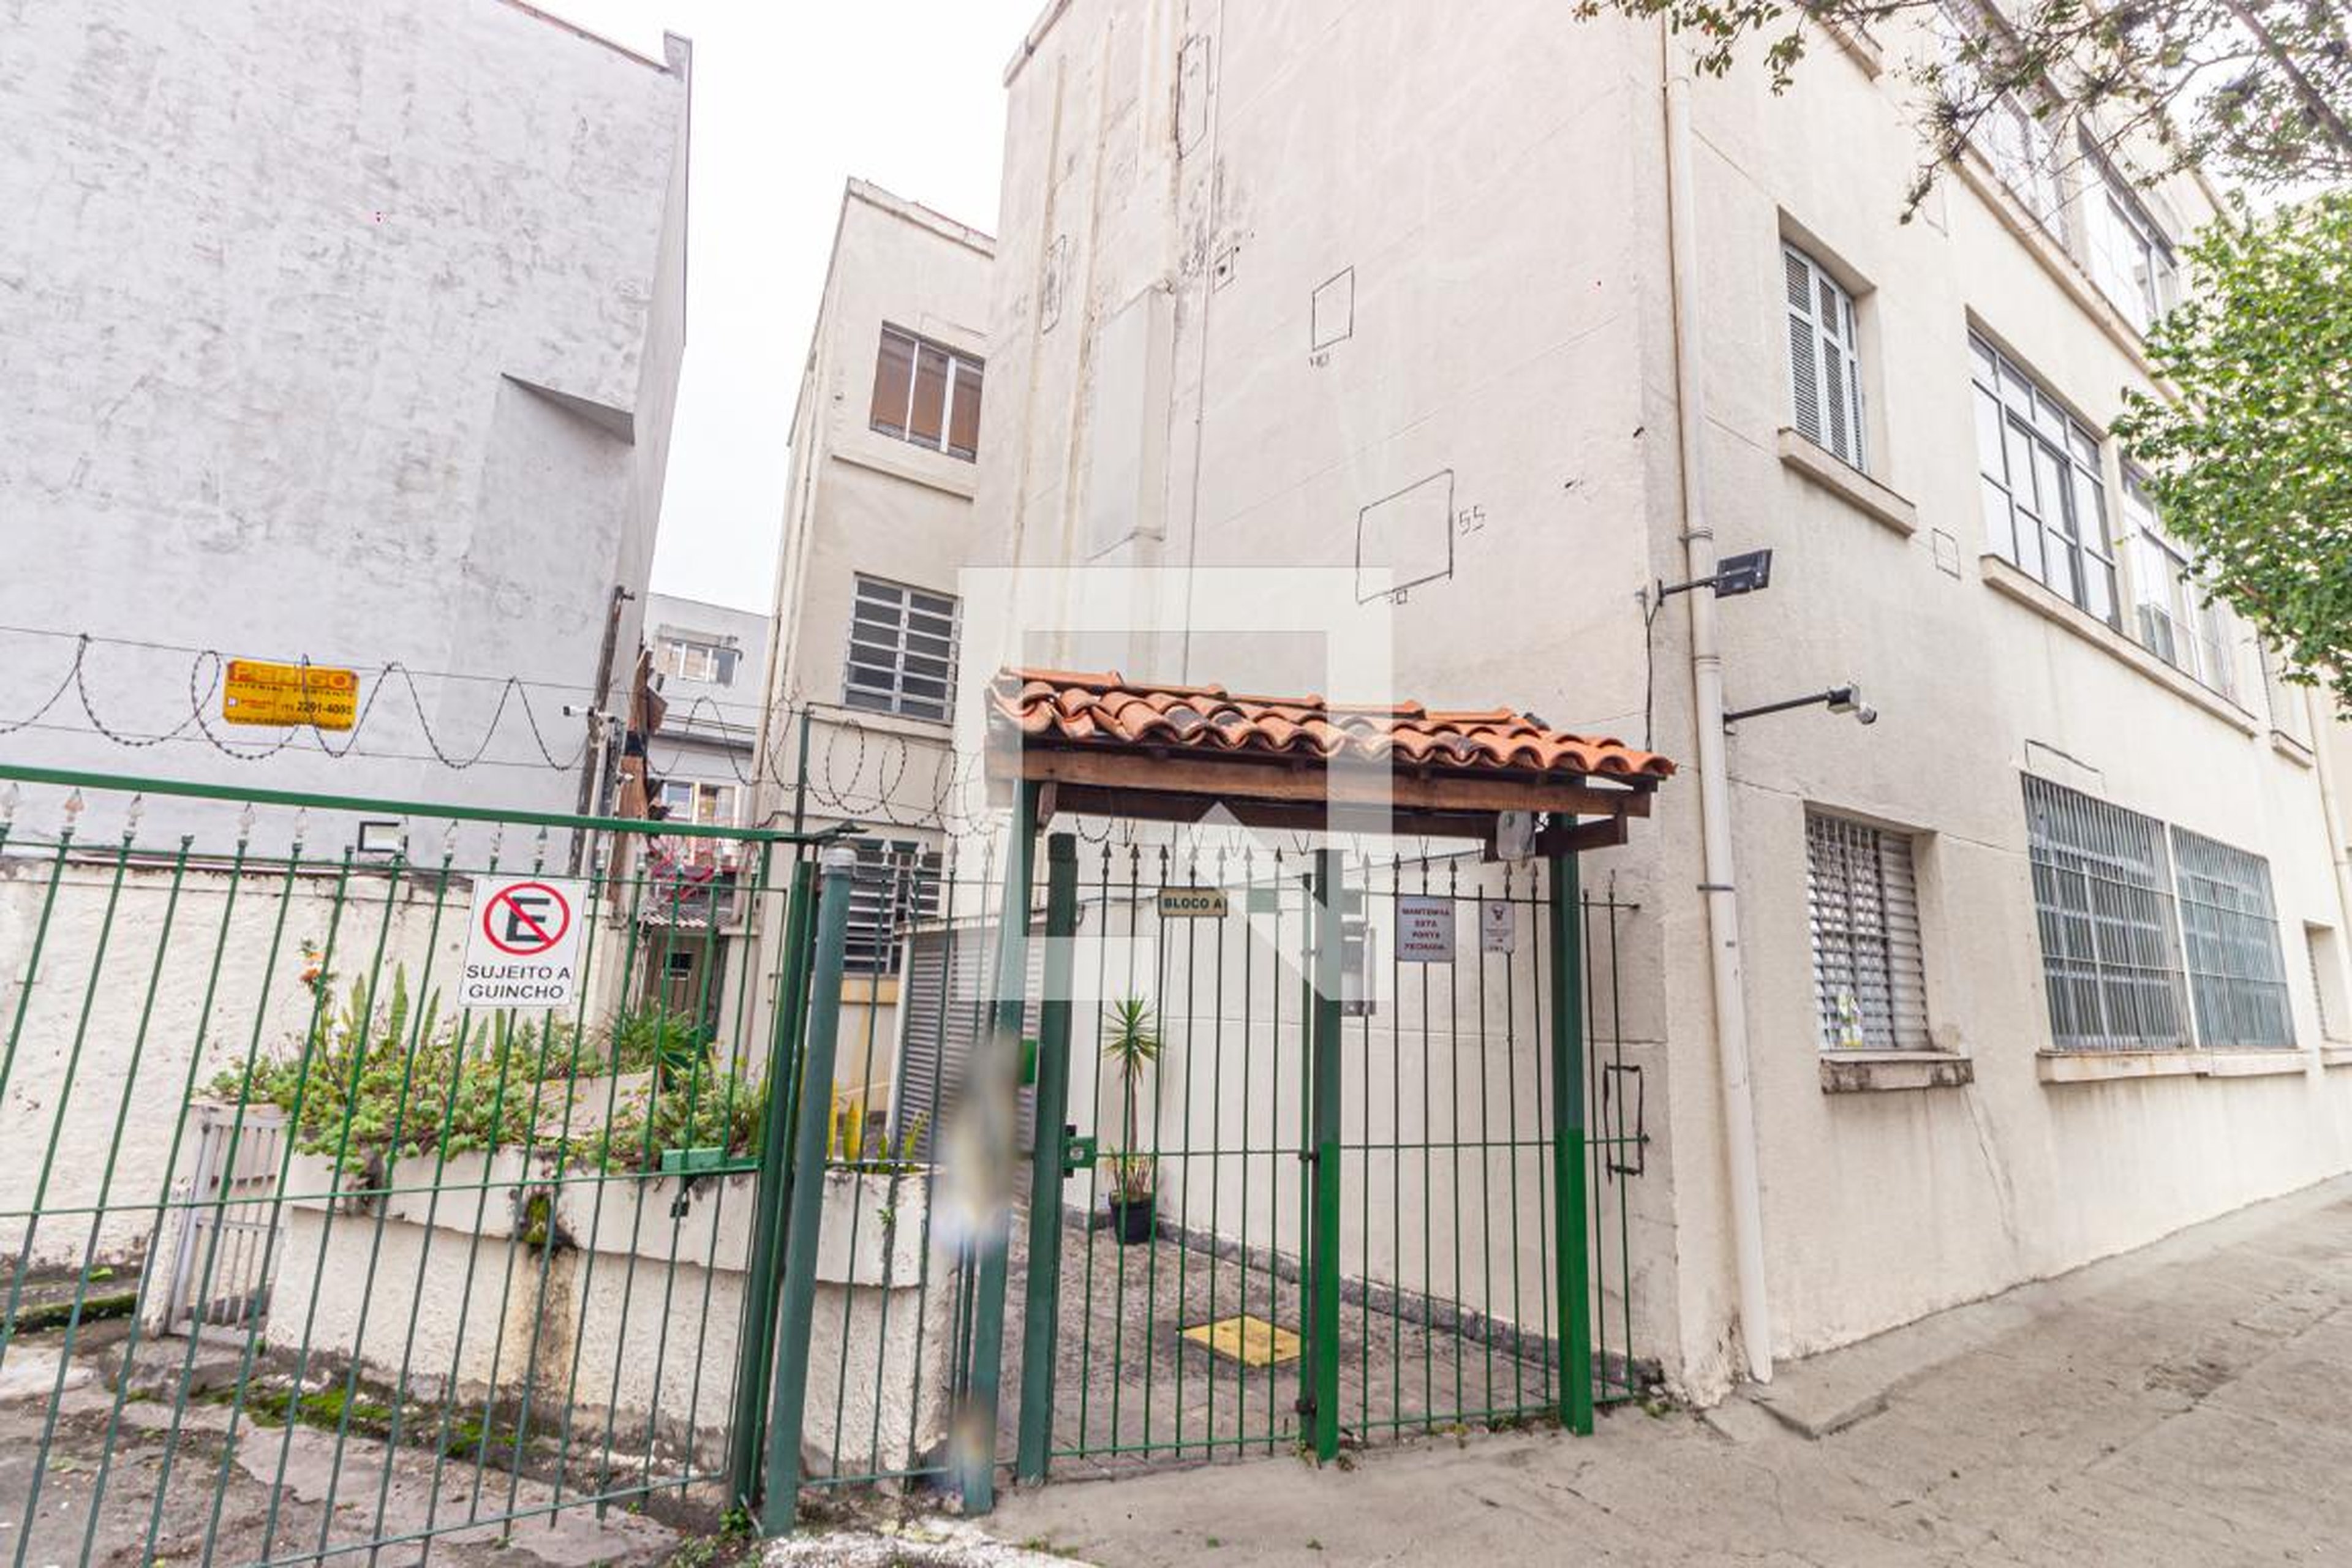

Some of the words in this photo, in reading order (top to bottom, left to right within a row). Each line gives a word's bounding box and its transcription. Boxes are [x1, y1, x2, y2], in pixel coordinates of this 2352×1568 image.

[1164, 897, 1209, 909] BLOCO
[1214, 898, 1222, 908] A
[466, 965, 552, 979] SUJEITO
[557, 967, 571, 979] A
[469, 984, 564, 999] GUINCHO
